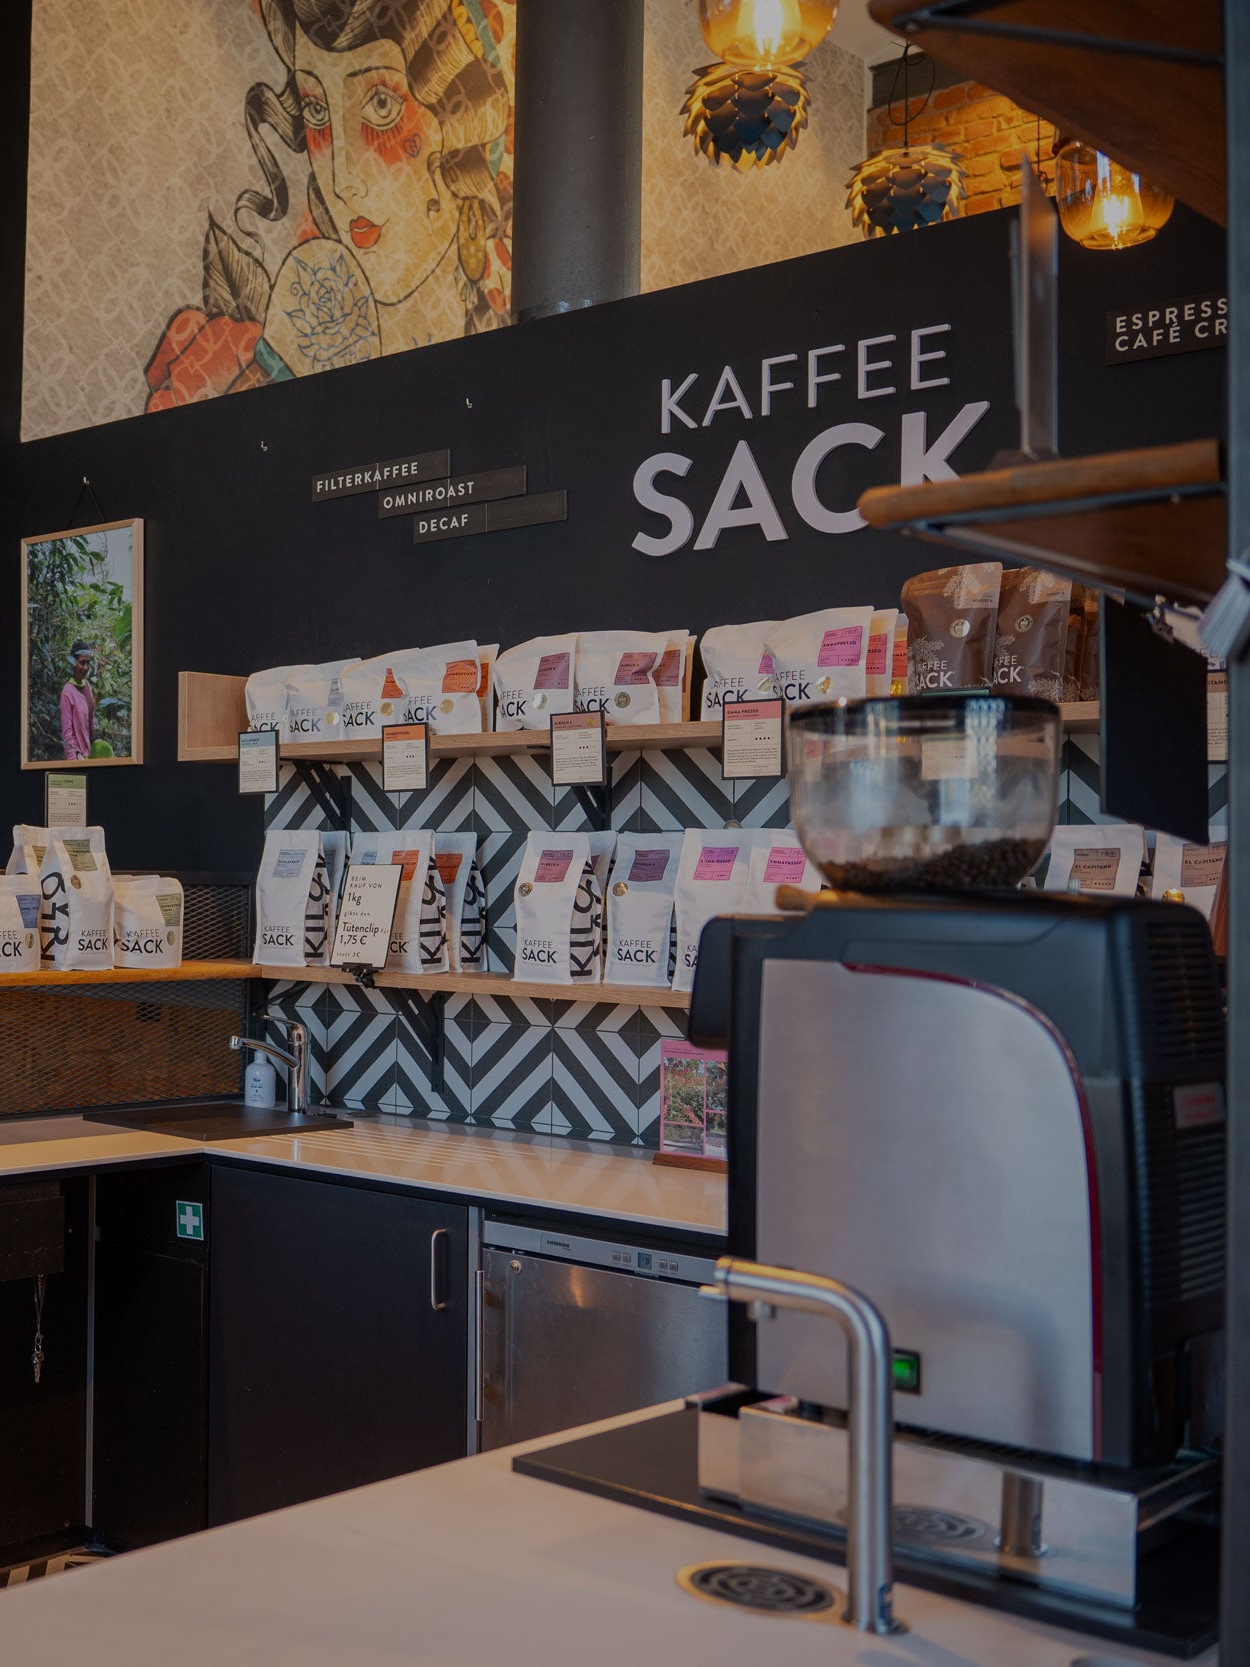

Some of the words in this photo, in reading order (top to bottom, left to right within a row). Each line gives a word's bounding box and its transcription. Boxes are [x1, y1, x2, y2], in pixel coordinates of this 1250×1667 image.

[1115, 321, 1181, 351] CAFÉ
[661, 323, 951, 434] KAFFEE
[317, 462, 419, 492] FILTERKAFFEE
[631, 401, 990, 557] SACK
[384, 482, 475, 509] OMNIROAST
[419, 514, 469, 533] DECAF
[82, 930, 106, 938] KAFFEE
[264, 925, 290, 933] KAFFEE
[78, 938, 108, 951] SACK
[121, 939, 163, 954] SACK
[262, 934, 294, 946] SACK
[525, 938, 552, 949] KAFFEE
[619, 939, 651, 949] KAFFEE
[523, 948, 557, 963] SACK
[618, 948, 656, 963] SACK
